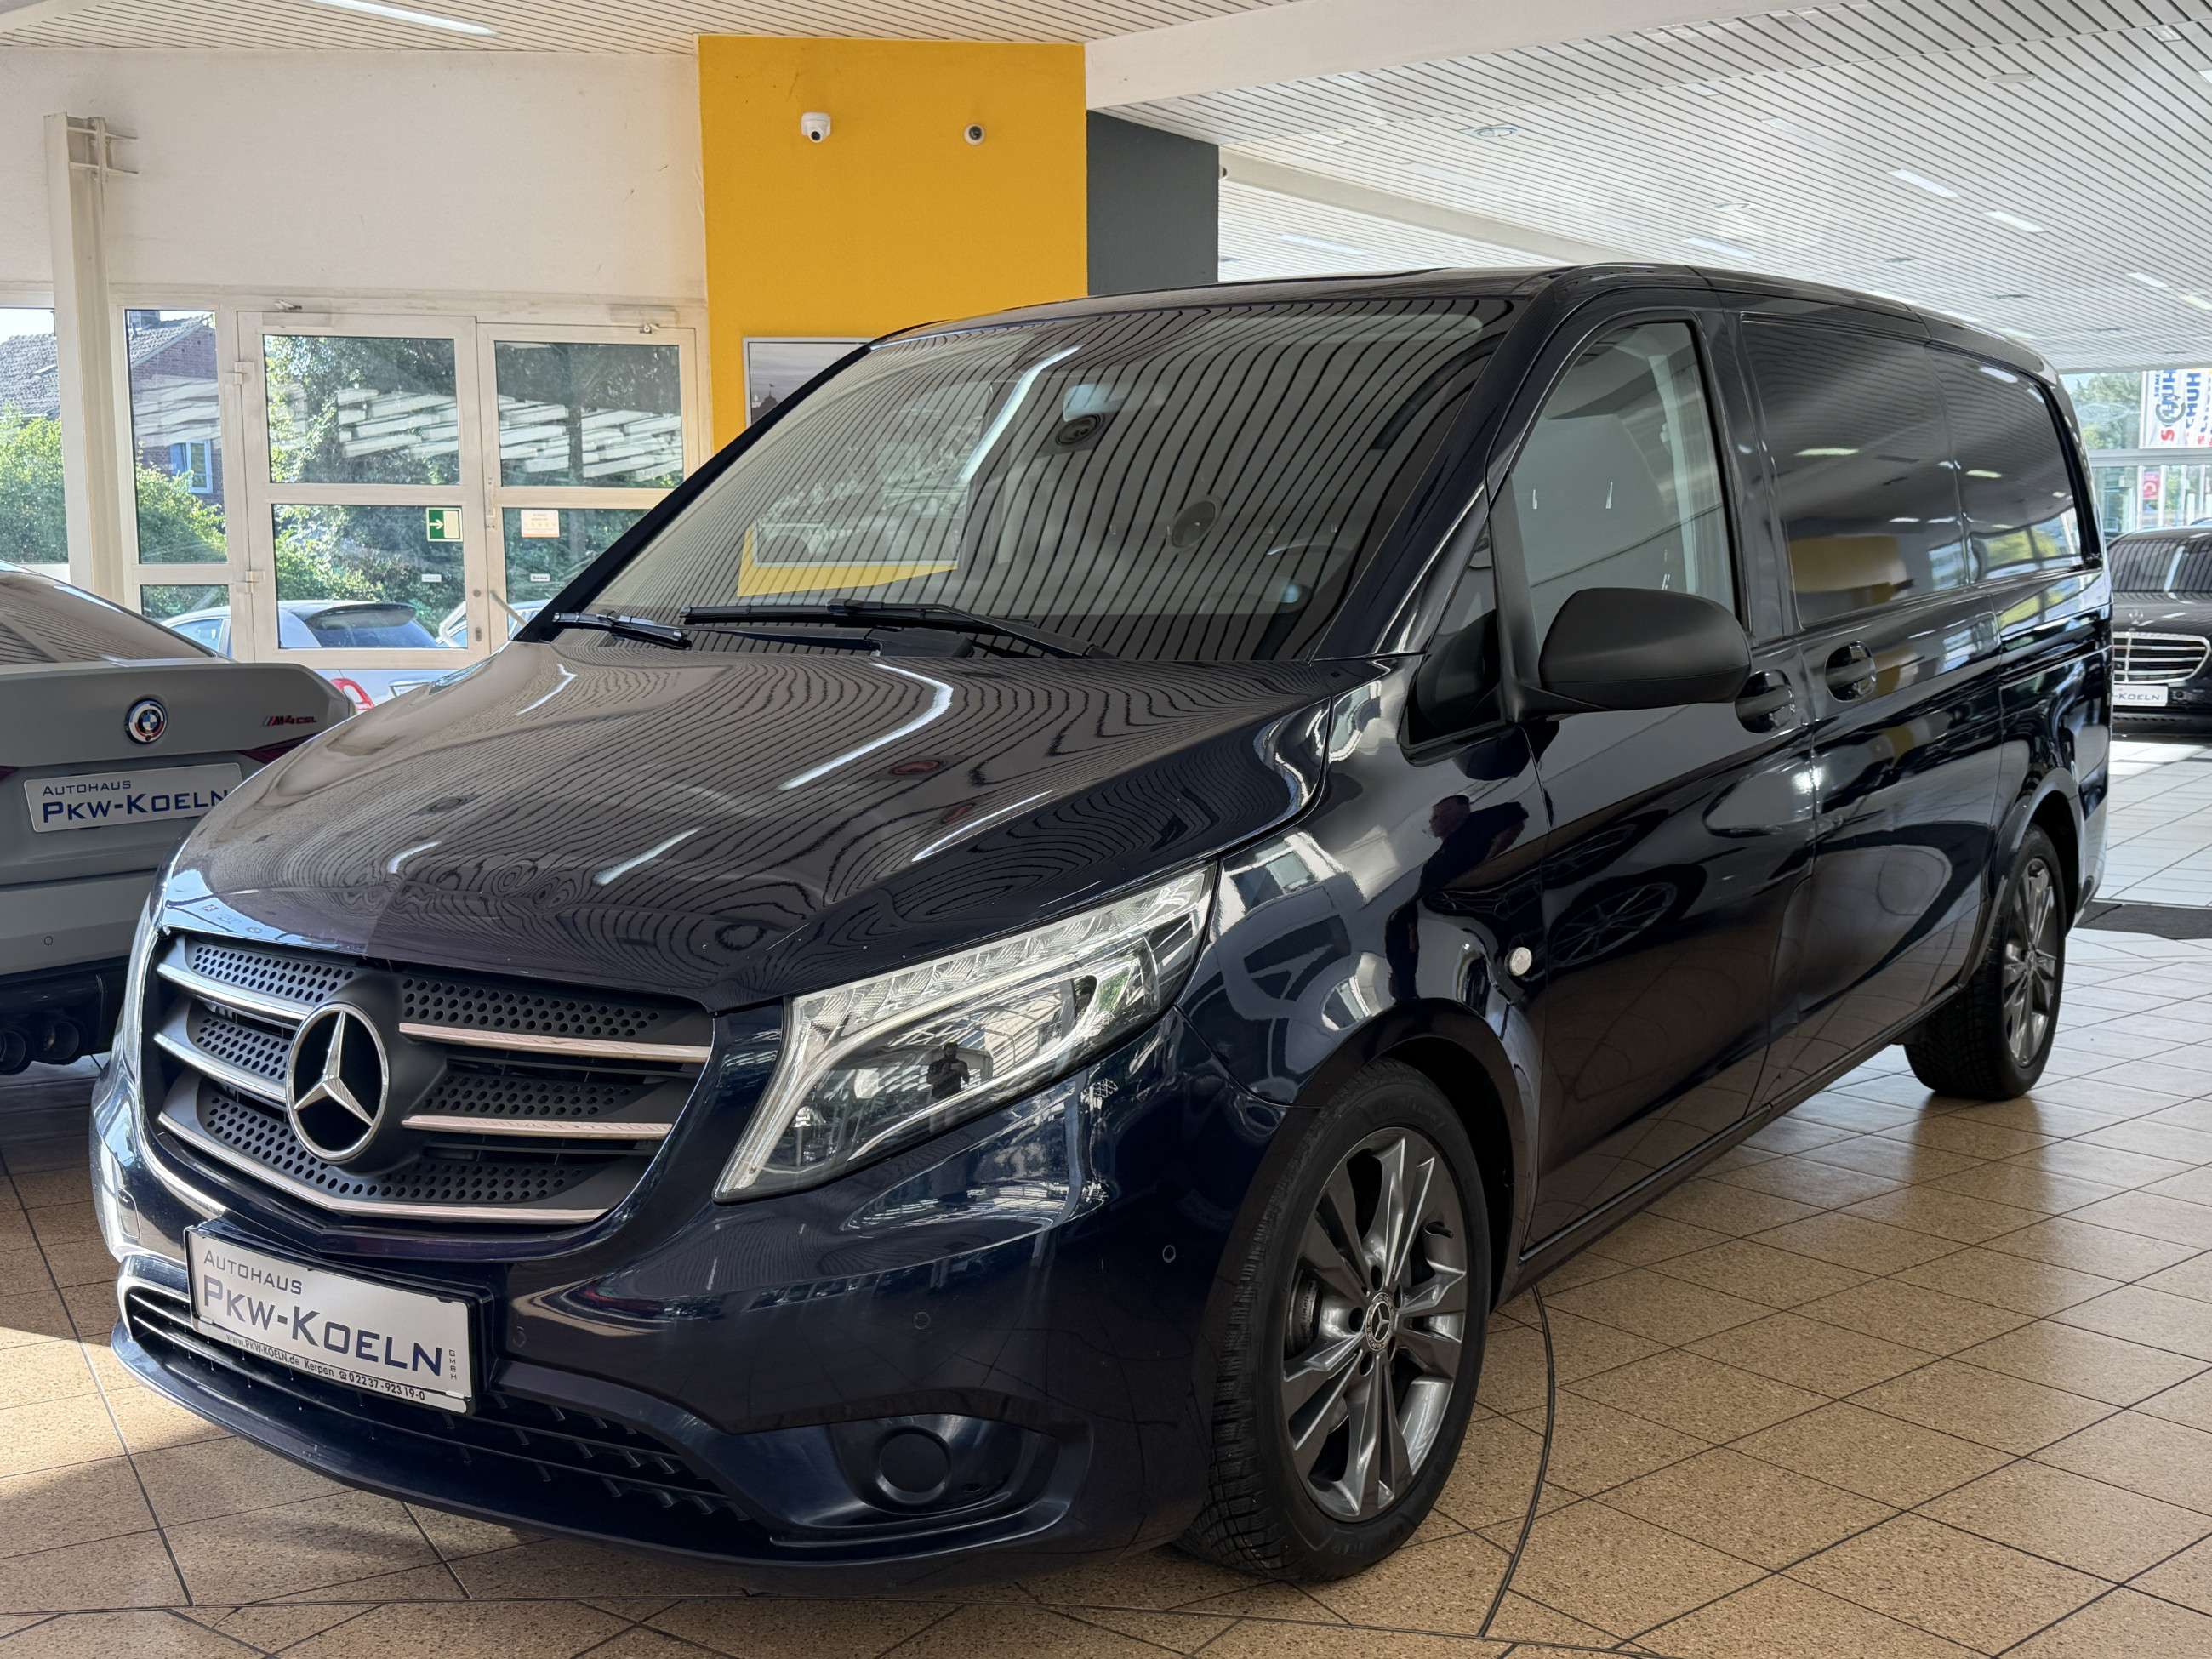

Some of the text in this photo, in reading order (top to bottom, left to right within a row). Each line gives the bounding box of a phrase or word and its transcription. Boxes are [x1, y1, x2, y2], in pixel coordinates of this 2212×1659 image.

[2112, 693, 2161, 701] -KOELN
[43, 779, 132, 796] AUTOHAUS
[203, 1249, 303, 1296] AUTOHAUS
[203, 1274, 442, 1377] PKW-KOELN
[305, 1359, 334, 1377] Kerpen
